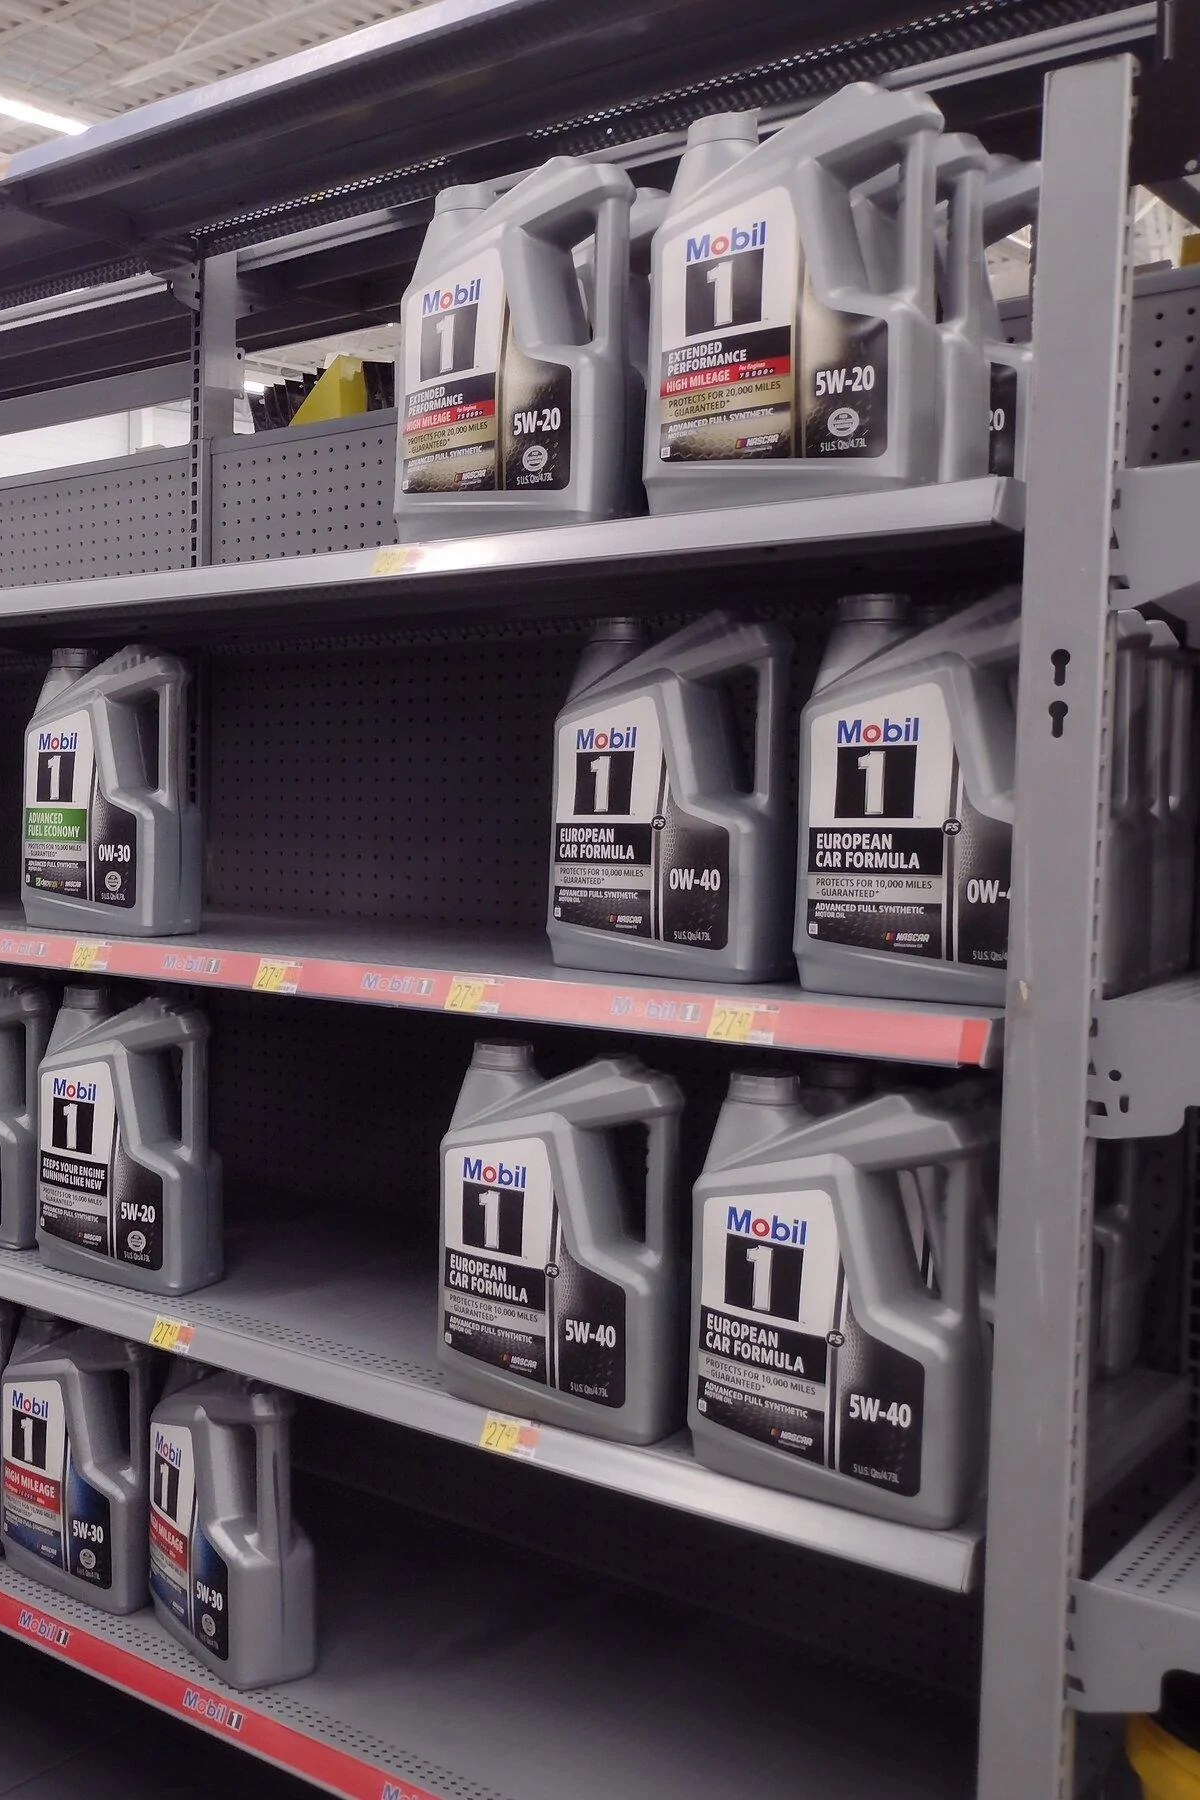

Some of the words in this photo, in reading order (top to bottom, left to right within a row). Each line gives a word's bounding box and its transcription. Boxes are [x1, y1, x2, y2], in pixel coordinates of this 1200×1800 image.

[686, 221, 766, 262] Mobil
[422, 279, 481, 315] Mobil
[707, 260, 734, 326] 1
[436, 314, 455, 374] 1
[668, 342, 722, 364] EXTENDED
[667, 349, 747, 377] PERFORMANCE
[666, 378, 688, 392] HIGH
[689, 369, 730, 387] MILEAGE
[815, 365, 875, 396] 5W-20
[408, 394, 463, 417] PERFORMANCE
[409, 387, 445, 406] EXTENDED
[669, 396, 706, 409] PROTECTS
[708, 392, 723, 401] FOR
[726, 386, 753, 398] 20,000
[755, 381, 780, 392] MILES
[514, 407, 560, 436] 5W-20
[668, 420, 707, 433] ADVANCED
[709, 416, 727, 426] FULL
[729, 408, 774, 423] SYNTHETIC
[746, 433, 781, 447] NASCAR
[39, 733, 77, 750] Mobil
[576, 727, 637, 750] Mobil
[837, 718, 920, 744] Mobil
[47, 755, 61, 800] 1
[591, 755, 611, 812] 1
[858, 751, 885, 815] 1
[28, 813, 62, 824] ADVANCED
[28, 825, 43, 836] FUEL
[44, 825, 80, 837] ECONOMY
[945, 823, 959, 831] FS
[560, 828, 614, 843] EUROPEAN
[816, 834, 892, 850] EUROPEAN
[99, 844, 130, 862] 0W-30
[559, 845, 579, 858] CAR
[580, 845, 634, 860] FORMULA
[815, 852, 841, 867] CAR
[846, 852, 920, 869] FORMULA
[601, 869, 622, 877] 10,000
[669, 868, 720, 890] 0W-40
[816, 878, 854, 887] PROTECTS
[856, 879, 872, 887] FOR
[875, 879, 903, 889] 10,000
[906, 881, 932, 889] MILES
[559, 889, 588, 897] ADVANCED
[589, 890, 603, 898] FULL
[604, 891, 638, 899] SYNTHETIC
[815, 903, 856, 911] ADVANCED
[858, 904, 877, 912] FULL
[878, 905, 924, 915] SYNTHETIC
[896, 932, 929, 942] NASCAR
[162, 953, 204, 972] Mobil
[361, 973, 412, 992] Mobil
[611, 996, 675, 1020] Mobil
[53, 1078, 96, 1101] Mobil
[64, 1103, 79, 1149] 1
[42, 1168, 69, 1185] RUNNING
[70, 1173, 84, 1186] LIKE
[86, 1176, 102, 1190] NEW
[43, 1157, 58, 1169] KEEPS
[60, 1160, 78, 1174] YOUR
[79, 1164, 105, 1179] ENGINE
[463, 1157, 526, 1188] Mobil
[120, 1202, 155, 1223] 5W-20
[478, 1190, 500, 1249] 1
[727, 1205, 807, 1245] Mobil
[450, 1254, 507, 1282] EUROPEAN
[747, 1245, 773, 1311] 1
[449, 1271, 469, 1289] CAR
[471, 1277, 528, 1303] FORMULA
[450, 1294, 478, 1308] PROTECTS
[479, 1301, 492, 1311] FOR
[494, 1304, 515, 1318] 10,000
[517, 1311, 538, 1322] MILES
[565, 1319, 616, 1348] 5W-40
[707, 1313, 778, 1348] EUROPEAN
[828, 1334, 842, 1344] FS
[706, 1331, 729, 1353] CAR
[733, 1340, 804, 1374] FORMULA
[705, 1357, 741, 1375] PROTECTS
[744, 1369, 759, 1380] FOR
[762, 1373, 789, 1389] 10,000
[791, 1381, 815, 1396] MILES
[12, 1390, 48, 1418] Mobil
[704, 1382, 743, 1402] ADVANCED
[744, 1393, 763, 1408] FULL
[765, 1399, 808, 1419] SYNTHETIC
[849, 1393, 911, 1429] 5W-40
[20, 1417, 33, 1462] 1
[156, 1431, 182, 1468] Mobil
[779, 1430, 813, 1447] NASCAR
[160, 1462, 170, 1511] 1
[72, 1520, 104, 1543] 5W-30
[196, 1581, 222, 1610] 5W-30
[18, 1610, 57, 1638] Mobil
[182, 1688, 226, 1723] Mobil
